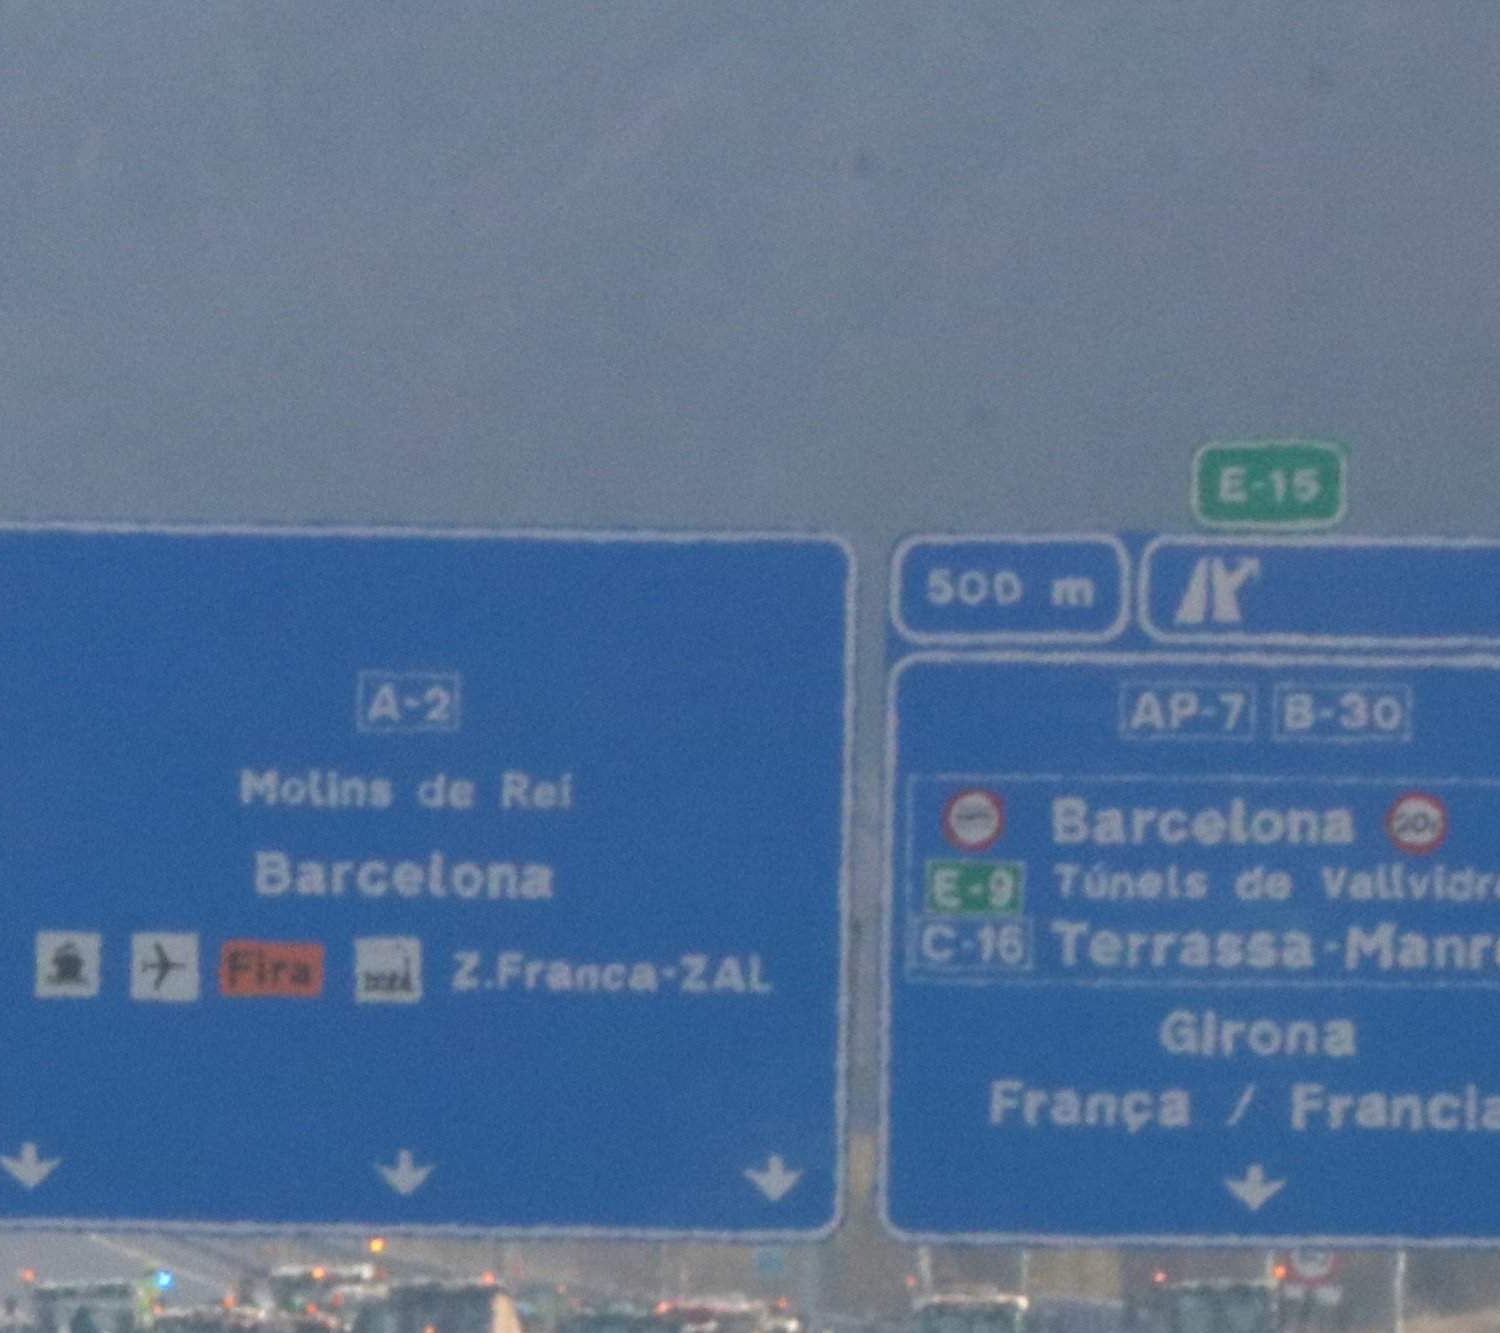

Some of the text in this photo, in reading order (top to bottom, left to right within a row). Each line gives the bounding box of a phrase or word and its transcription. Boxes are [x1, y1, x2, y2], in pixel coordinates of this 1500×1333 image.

[1218, 465, 1320, 503] E-15
[926, 569, 1095, 607] 500 m
[366, 682, 452, 722] A-2
[1130, 692, 1245, 731] AP-7
[1284, 693, 1403, 732] B-30
[240, 768, 573, 811] Molins de Rei
[1052, 797, 1355, 844] Barcelona
[254, 849, 556, 900] Barcelona
[932, 867, 1013, 908] E-9
[1054, 861, 1209, 901] Túnels
[1235, 864, 1293, 901] de
[919, 923, 1025, 965] C-16
[225, 946, 317, 991] Fira
[1161, 1009, 1357, 1056] Girona
[989, 1079, 1192, 1133] França
[1226, 1088, 1256, 1126] /
